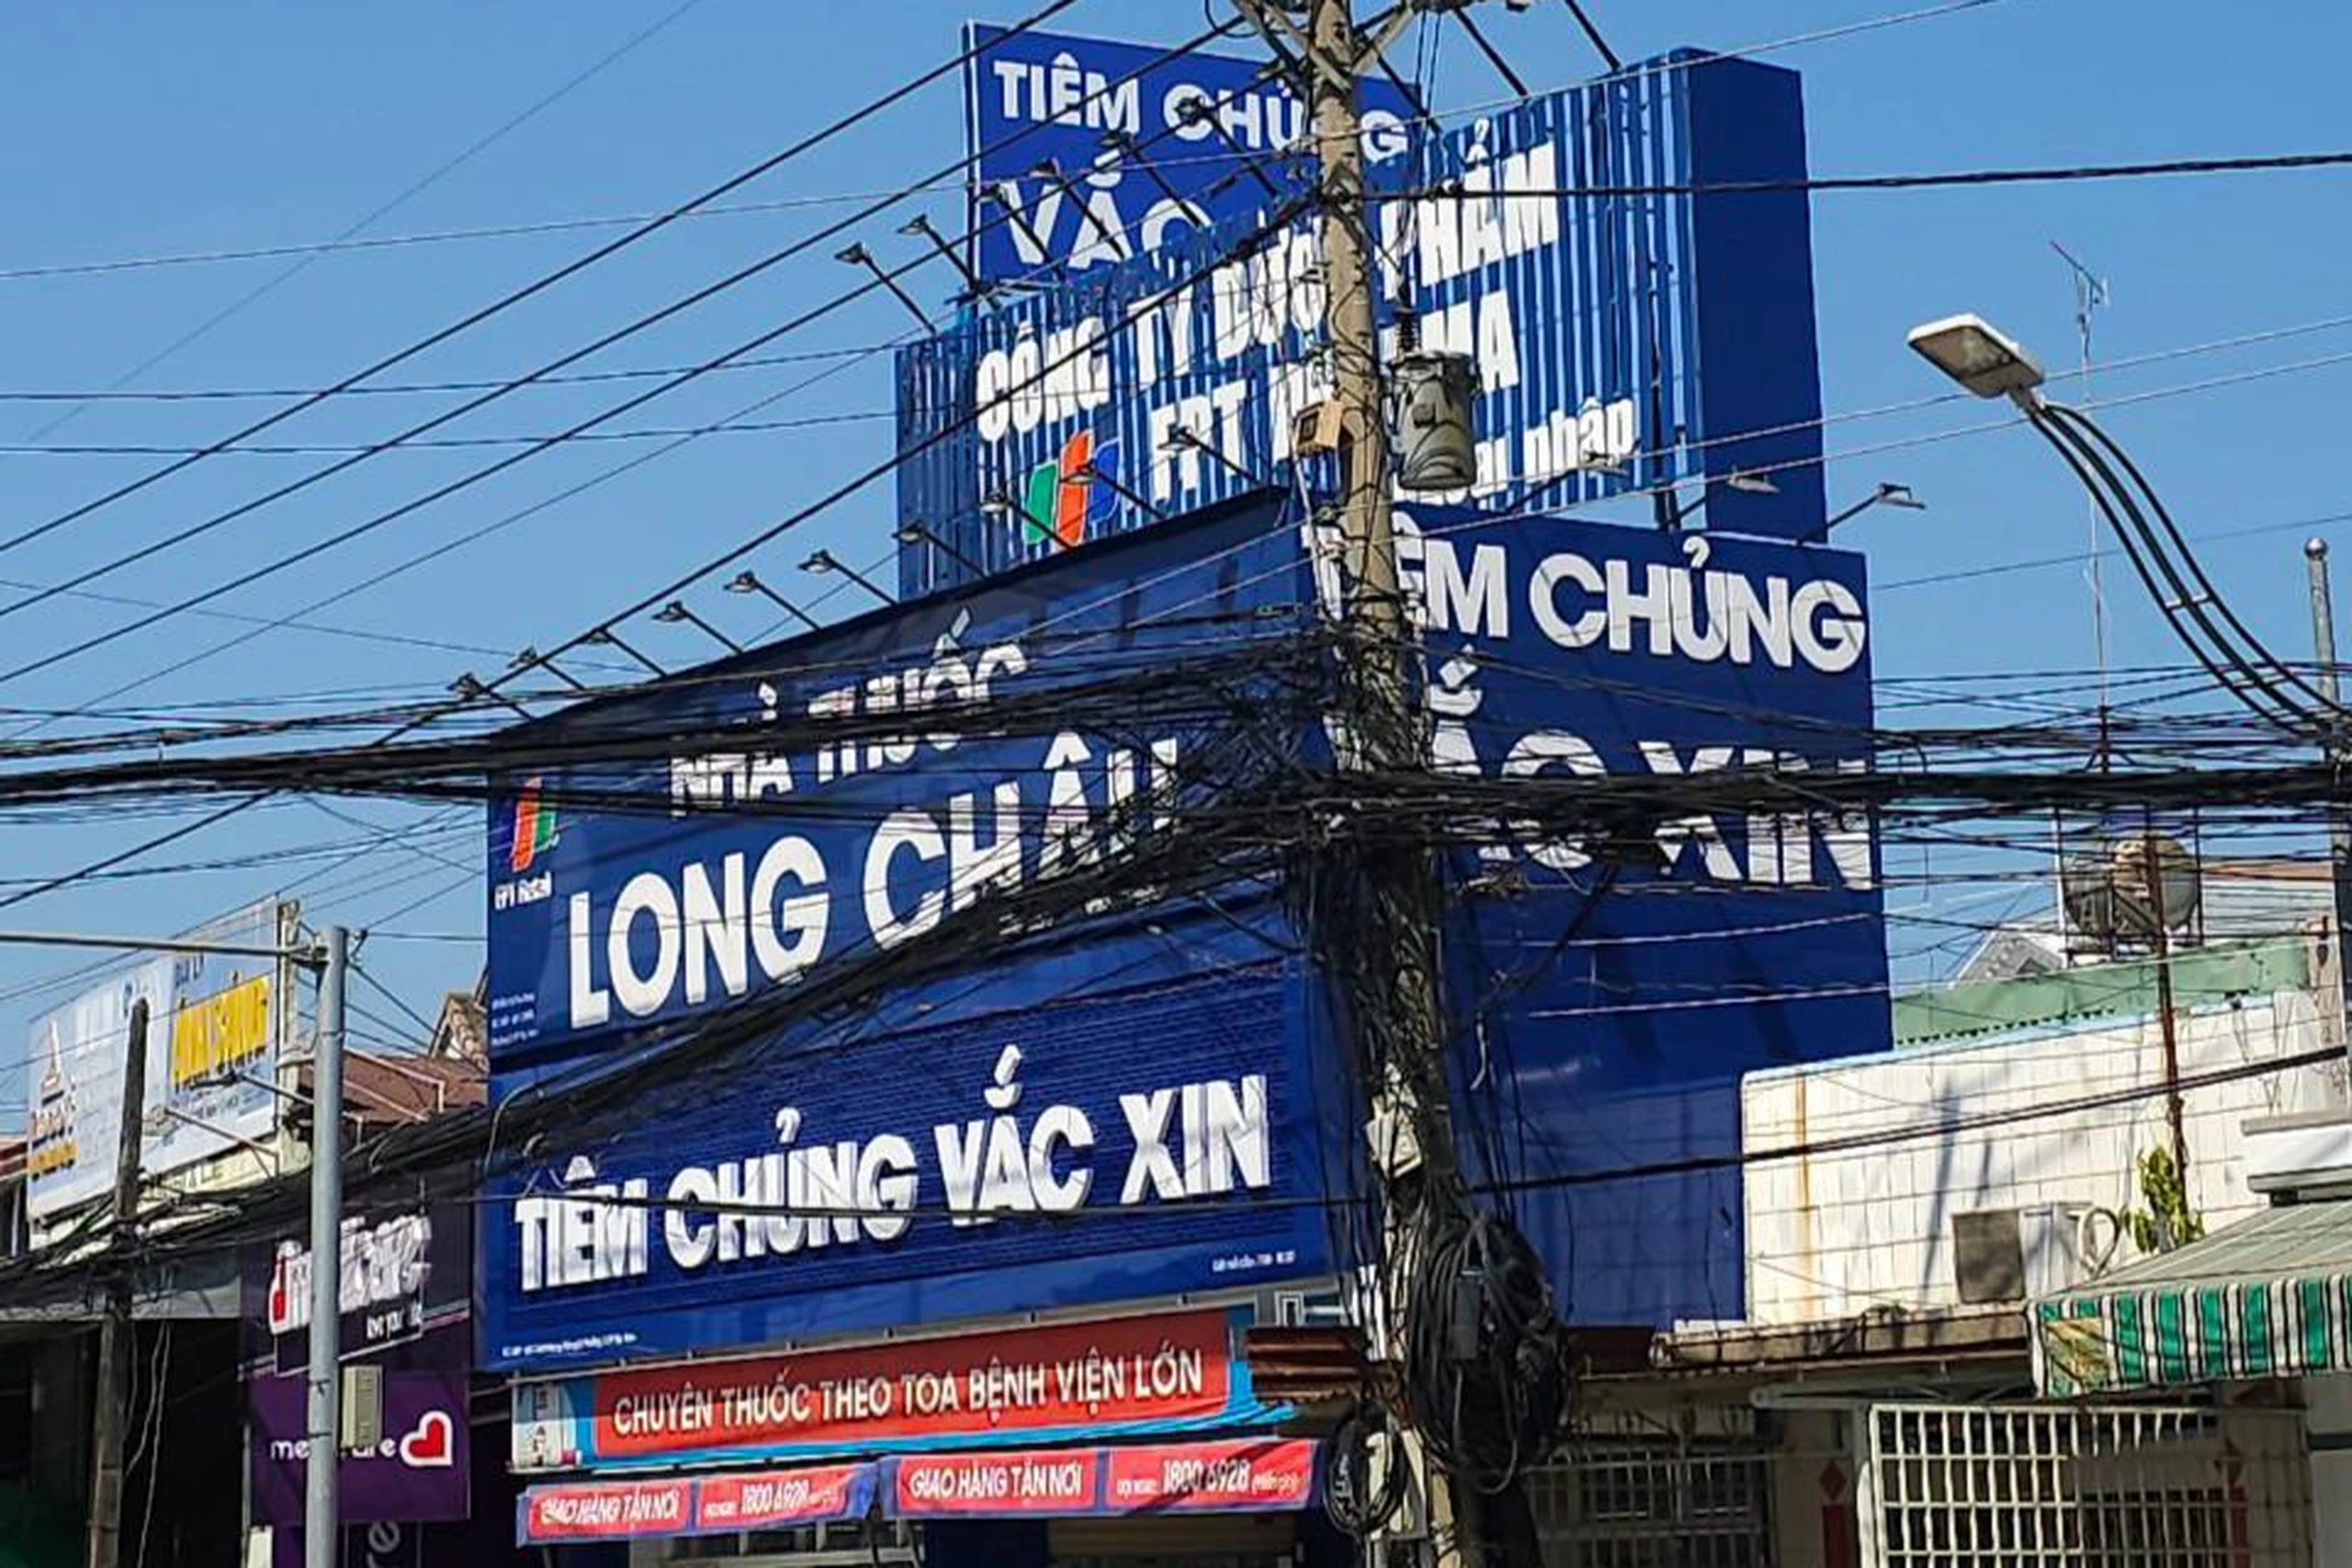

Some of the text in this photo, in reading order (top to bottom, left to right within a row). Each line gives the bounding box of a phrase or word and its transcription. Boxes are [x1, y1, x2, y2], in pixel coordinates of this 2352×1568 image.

[993, 51, 1408, 164] TIÊM CHỦG
[977, 317, 1110, 442] CÔNG
[1127, 285, 1193, 391] TY
[1150, 378, 1247, 501] FPT
[1529, 536, 1865, 673] CHỦNG
[570, 835, 829, 1029] LONG
[514, 1156, 649, 1292] TIÊM
[664, 1107, 918, 1269] CHỦNG
[934, 1043, 1095, 1227] VẮC
[1119, 1075, 1272, 1204] XIN
[614, 1340, 1202, 1436] CHUYÊN THUỐC THEO TOA BỆNH VIỆN LỚN
[910, 1468, 955, 1498] GIAO
